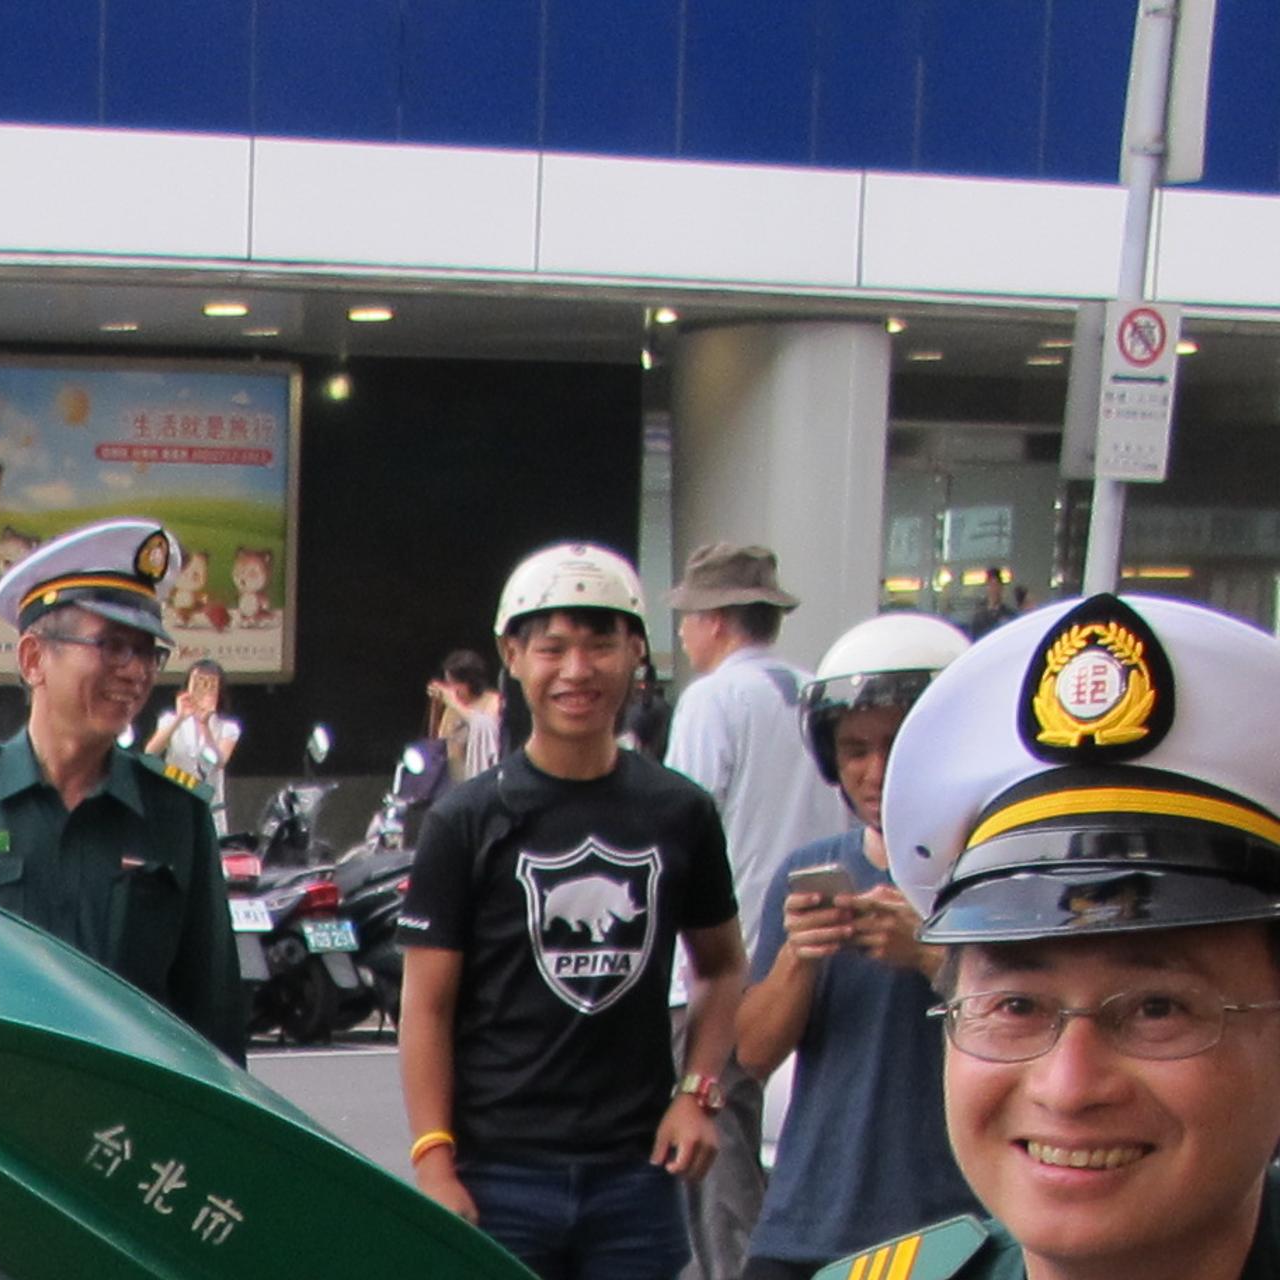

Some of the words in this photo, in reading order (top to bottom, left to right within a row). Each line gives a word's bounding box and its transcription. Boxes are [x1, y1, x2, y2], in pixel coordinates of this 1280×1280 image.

[554, 952, 632, 975] PPINA
[85, 1125, 244, 1245] 台北市
